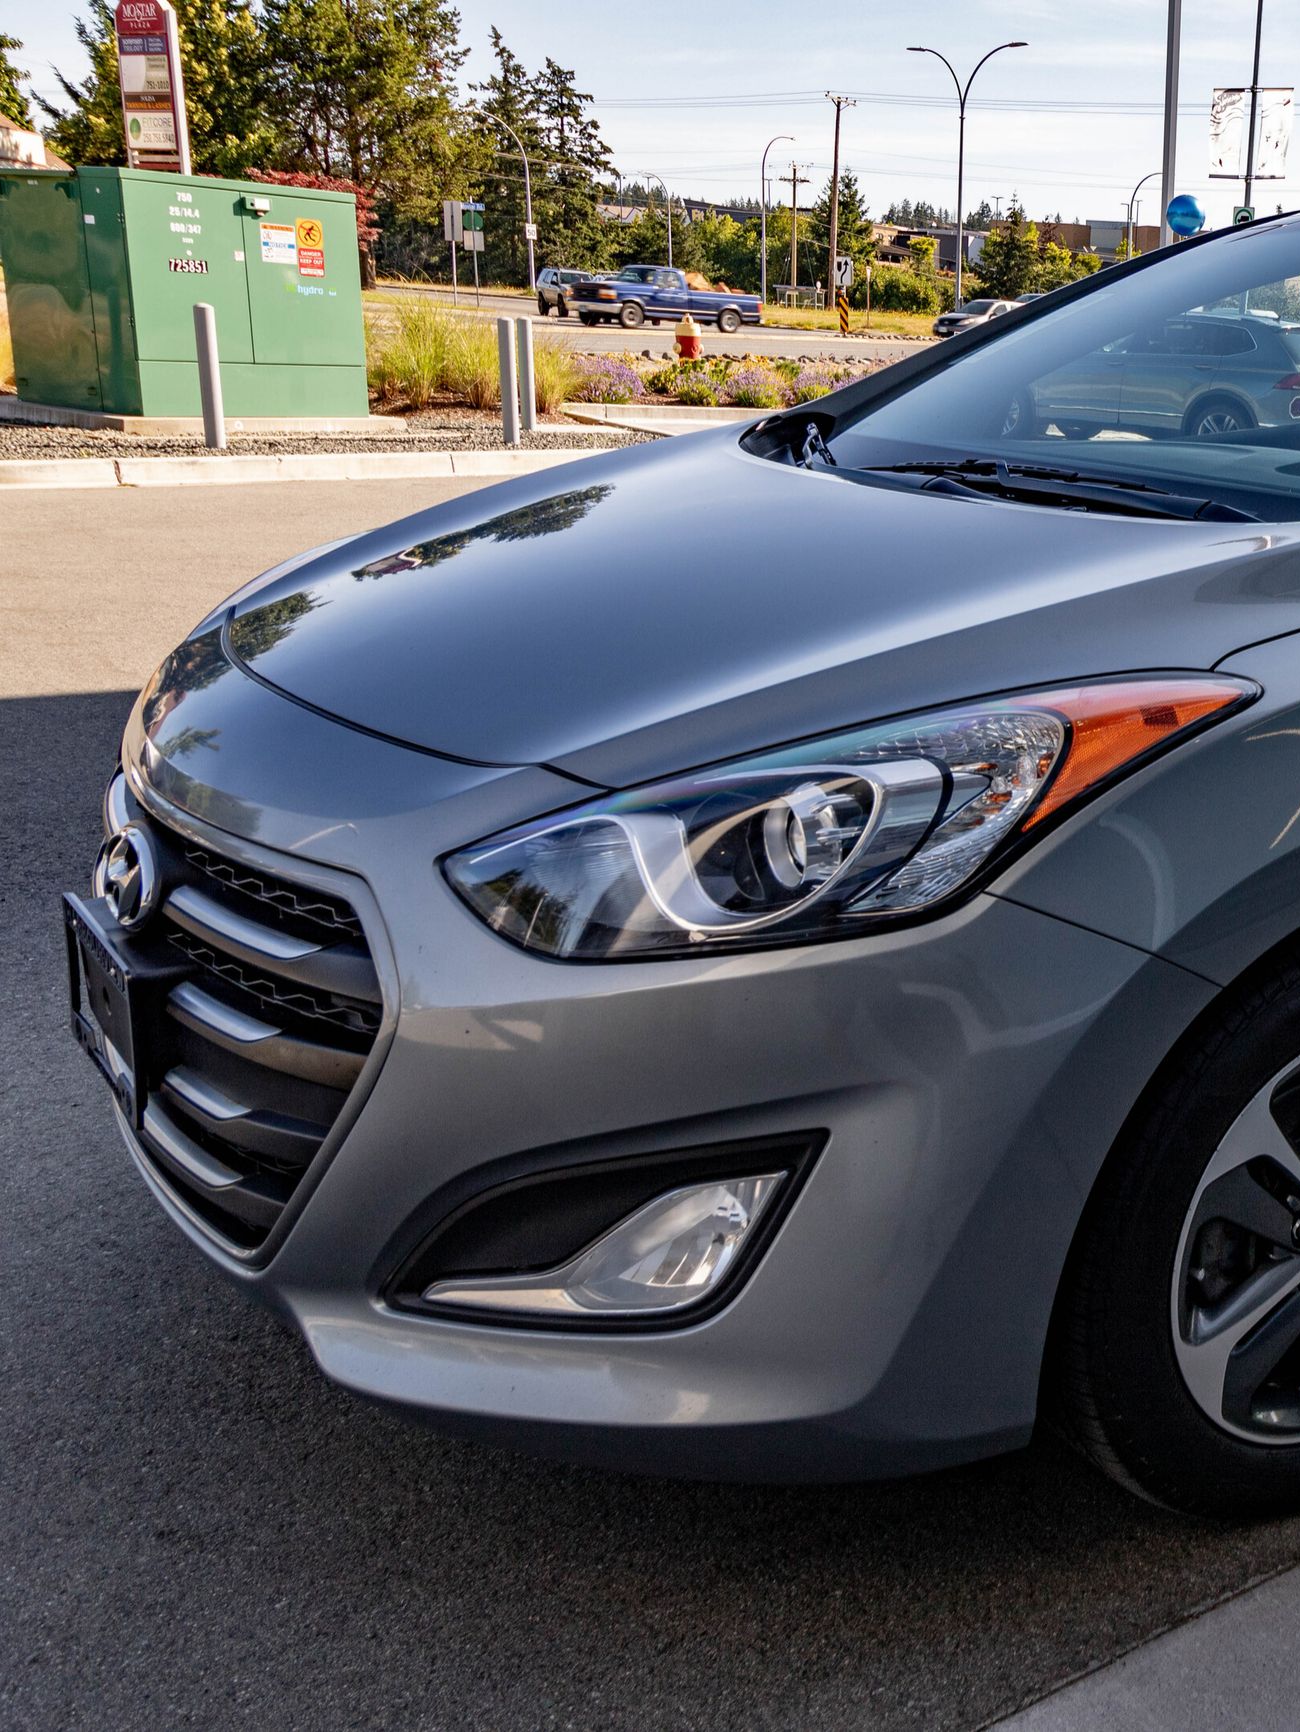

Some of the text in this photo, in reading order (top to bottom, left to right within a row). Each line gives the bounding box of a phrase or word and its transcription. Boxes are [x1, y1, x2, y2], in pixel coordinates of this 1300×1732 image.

[122, 3, 157, 21] MOSTAR
[130, 21, 151, 29] PLAZA
[169, 258, 208, 274] 725851
[297, 284, 324, 296] hydro
